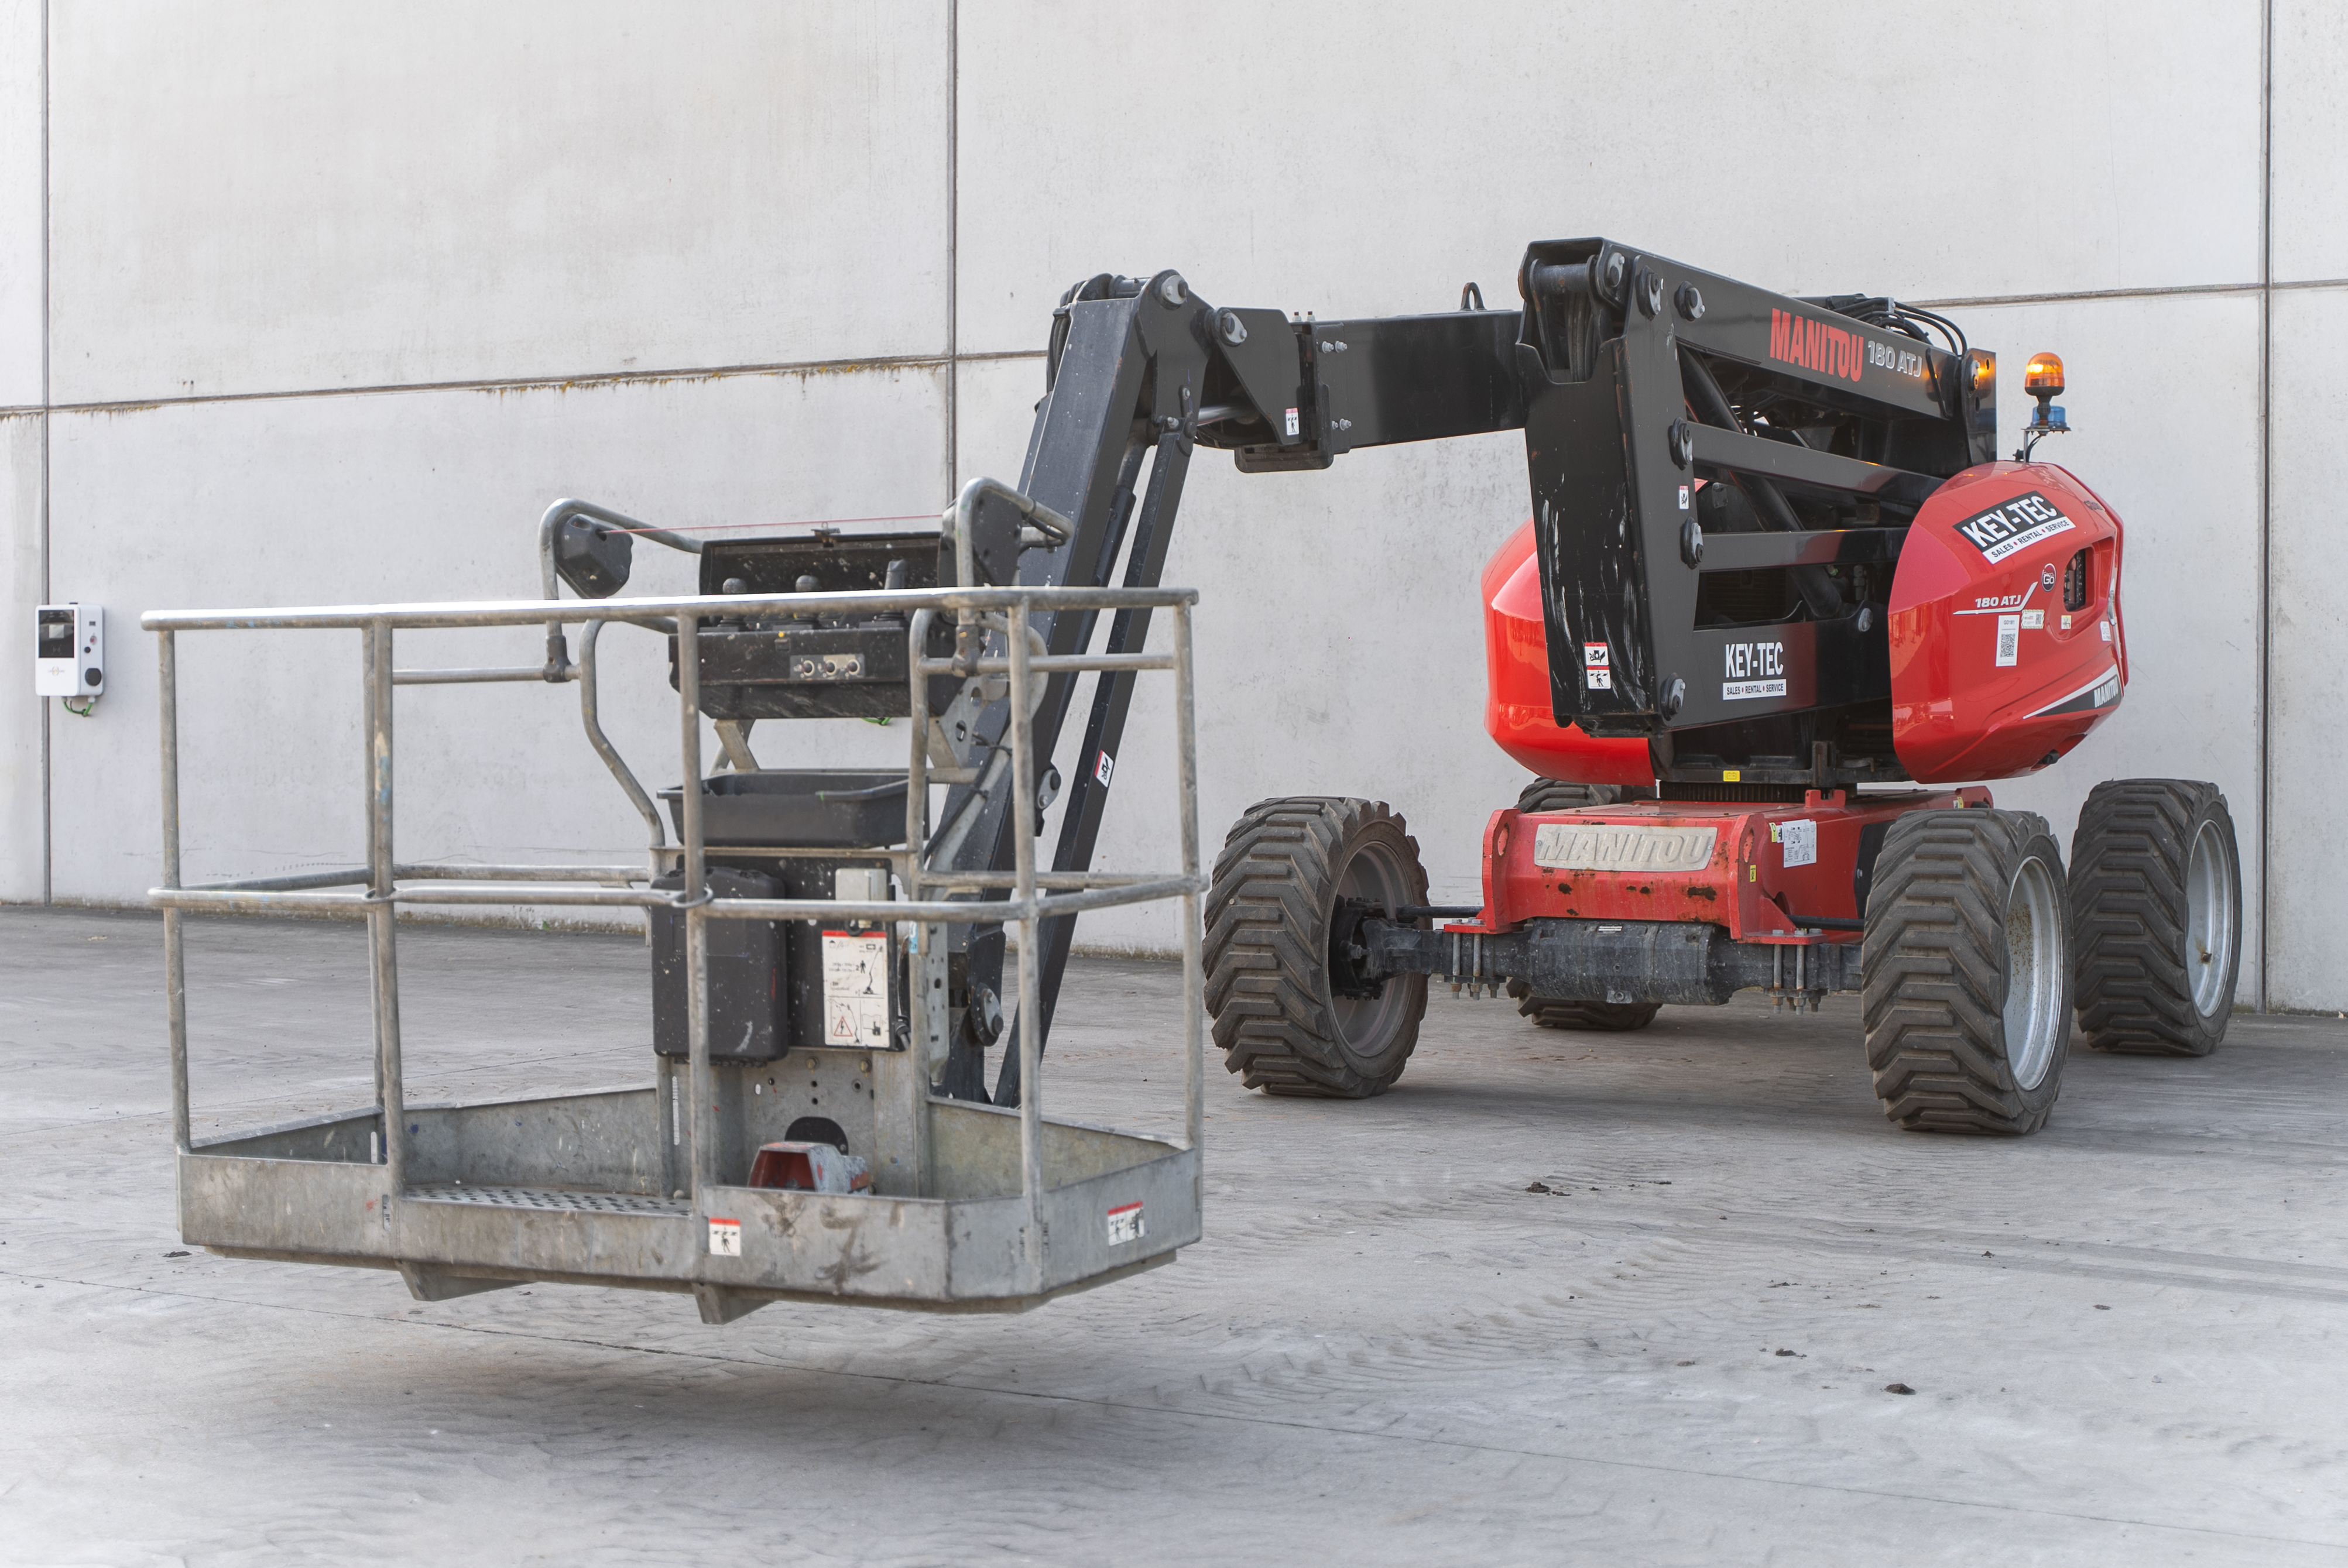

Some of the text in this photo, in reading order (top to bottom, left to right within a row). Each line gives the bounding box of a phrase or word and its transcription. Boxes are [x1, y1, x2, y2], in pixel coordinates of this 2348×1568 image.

[1770, 308, 1864, 382] MANITOU
[1867, 340, 1922, 378] 180 ATJ
[1962, 496, 2058, 548] KEY-TEC
[1991, 520, 2070, 558] SALES RENTAL SERVICE
[1975, 595, 2021, 608] 180 ATJ
[1725, 641, 1784, 678] KEY-TEC
[1726, 684, 1784, 695] SALES RENTAL SERVICE
[2094, 675, 2119, 708] MANITOU
[1537, 832, 1713, 864] MANITOU
